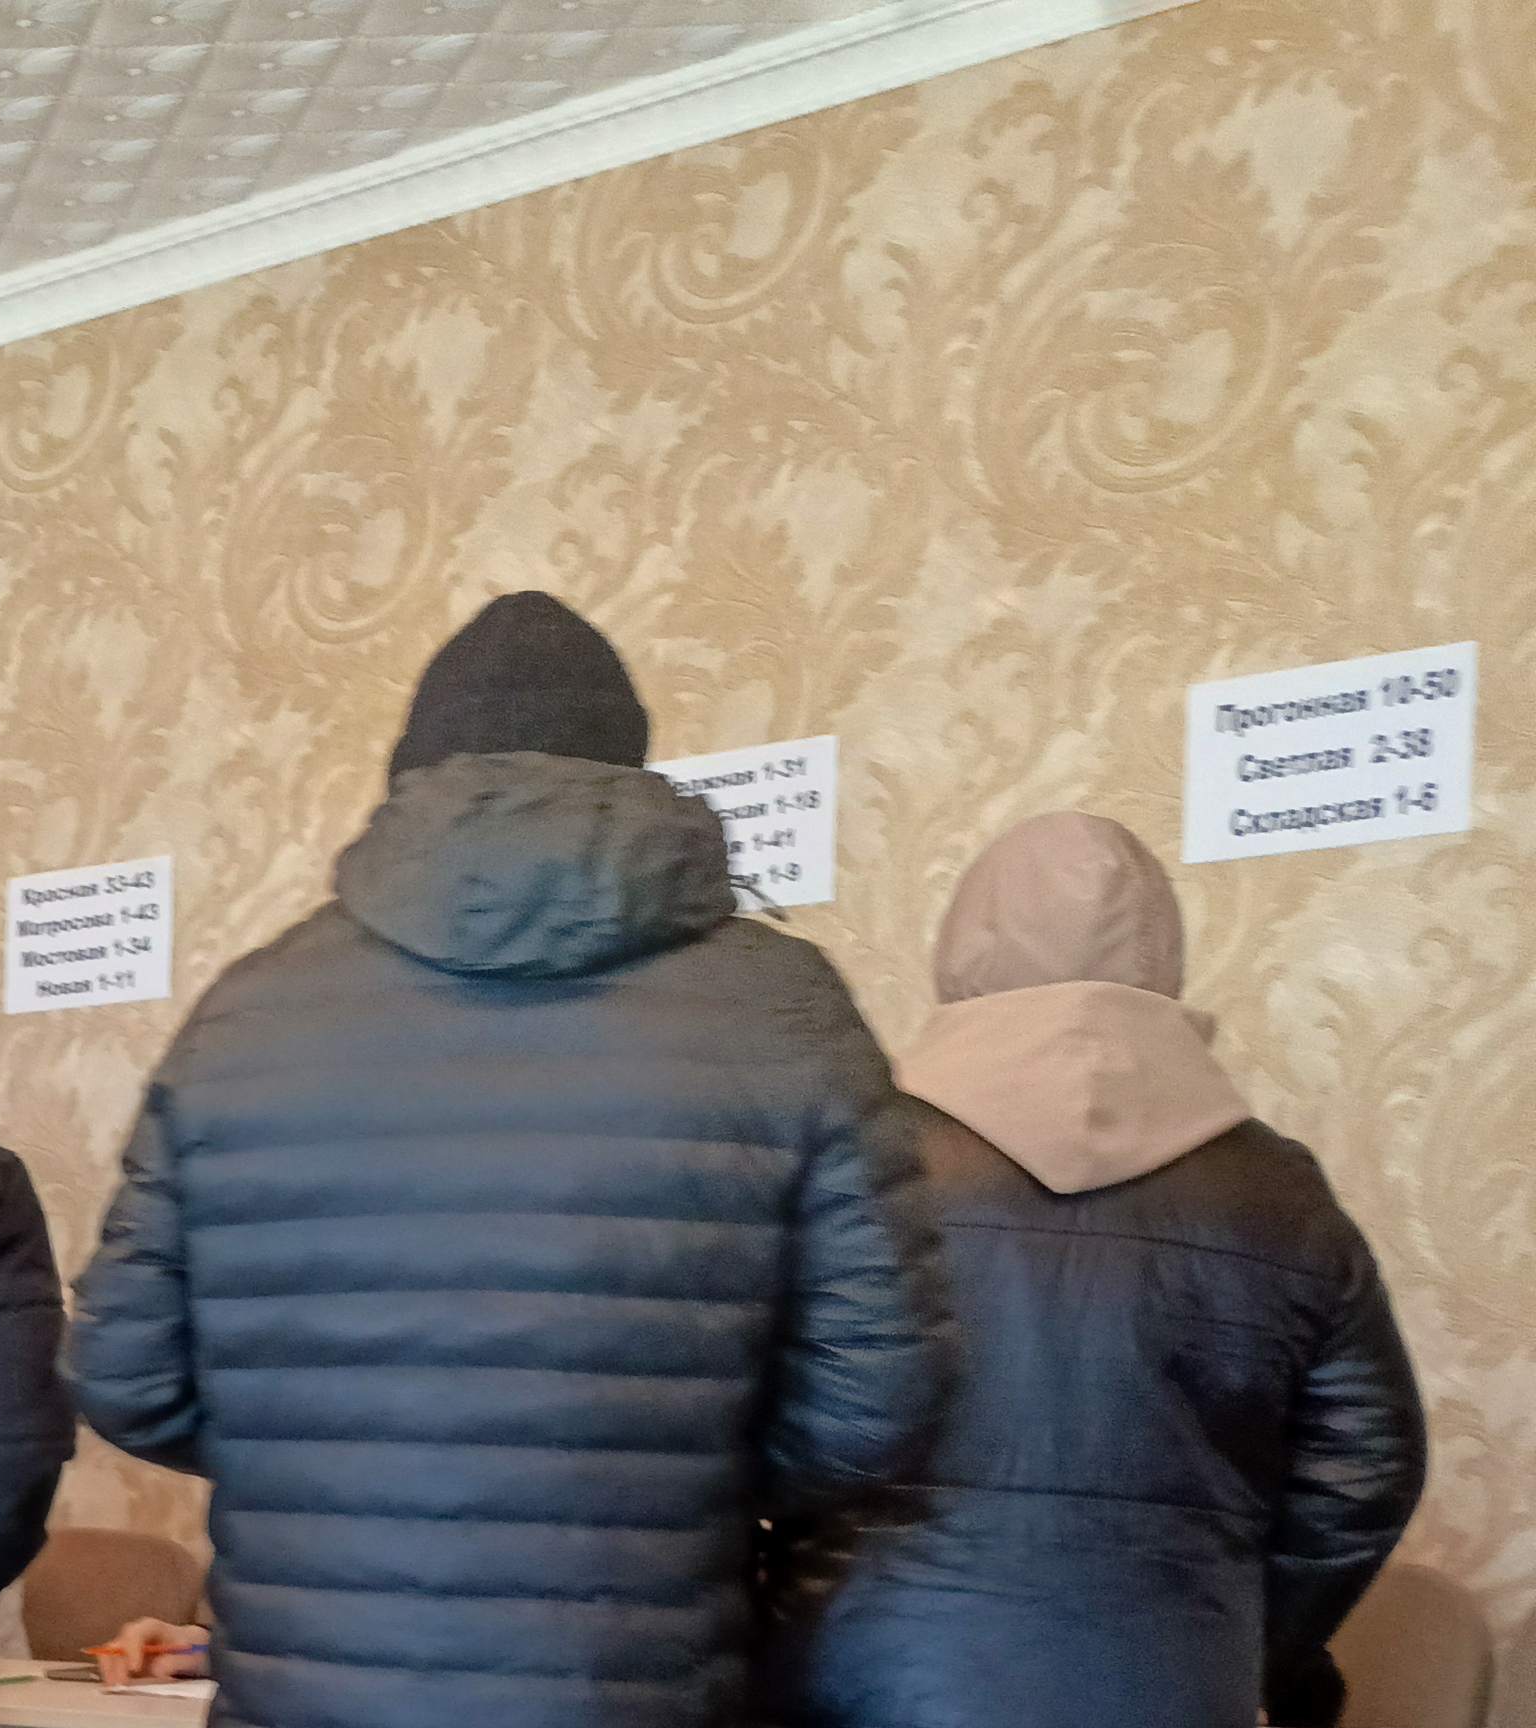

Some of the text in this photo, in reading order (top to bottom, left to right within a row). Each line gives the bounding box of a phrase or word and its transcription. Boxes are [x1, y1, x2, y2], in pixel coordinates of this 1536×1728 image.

[1214, 667, 1461, 737] Прогонная 10-50
[1238, 728, 1433, 782] Светлая 2-38
[1230, 781, 1439, 837] Складская 1-6
[21, 871, 156, 908] Красная 33-43
[17, 903, 160, 938] Матросова 1-43
[20, 935, 152, 968] Мостовая 1-34
[35, 969, 136, 998] Новая 1-11
